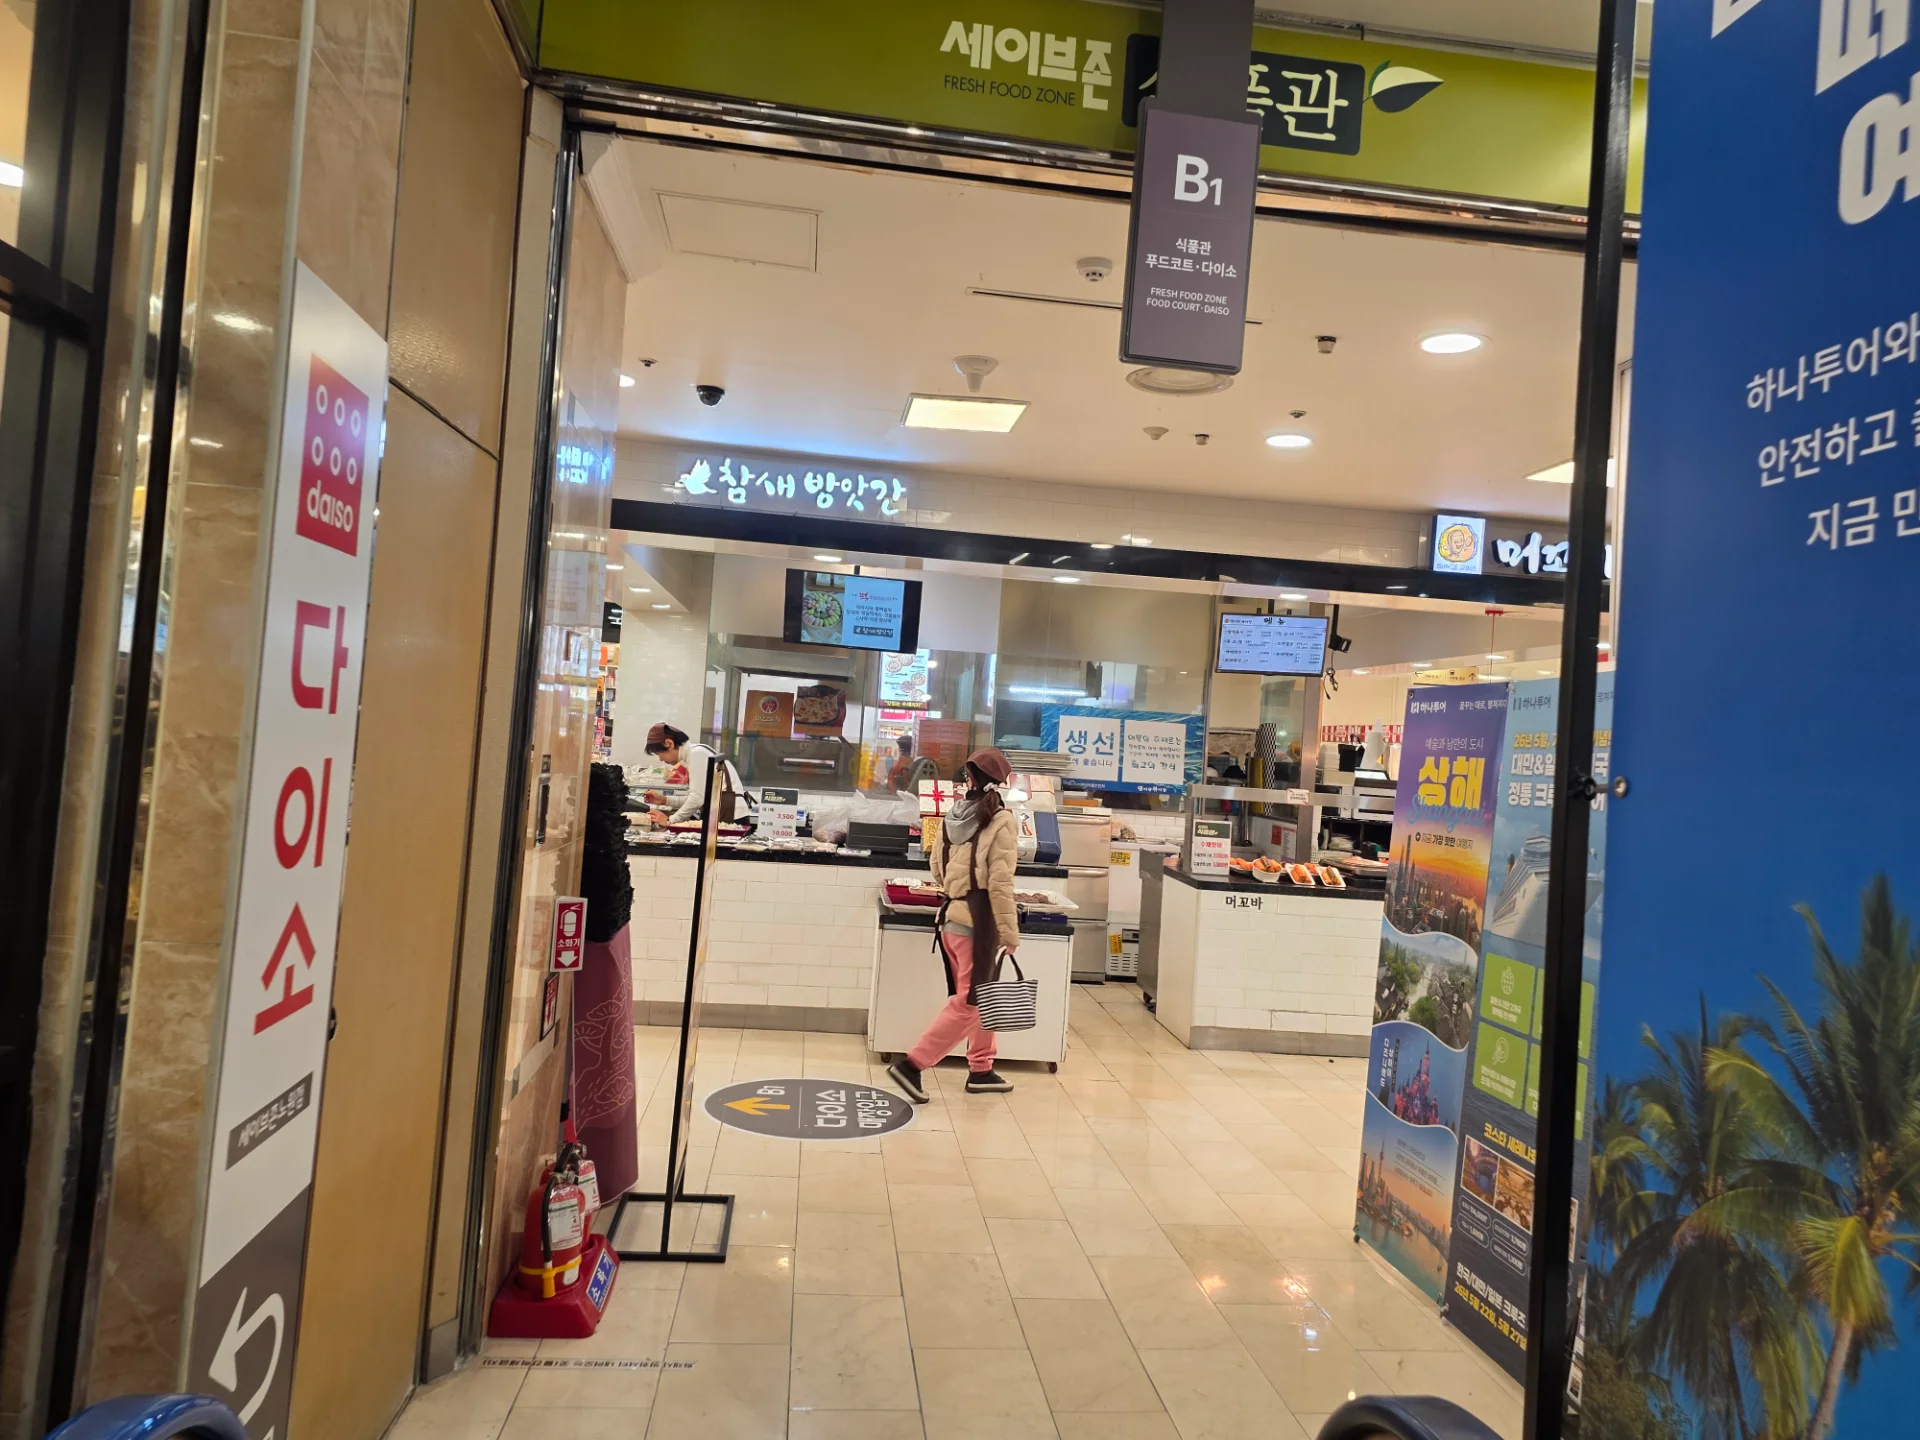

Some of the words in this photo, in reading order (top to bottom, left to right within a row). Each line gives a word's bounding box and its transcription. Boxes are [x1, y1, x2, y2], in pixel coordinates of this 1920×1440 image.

[940, 21, 1112, 111] 세이브존
[944, 75, 985, 94] FRESH
[990, 81, 1032, 100] FOOD
[1036, 88, 1076, 106] ZONE
[1174, 154, 1223, 206] B1
[1175, 237, 1212, 256] 식품관
[1146, 297, 1171, 309] FOOD
[1150, 287, 1178, 298] FRESH
[1179, 291, 1203, 301] FOOD
[1204, 294, 1228, 305] ZONE
[1758, 416, 1898, 487] 안전하고
[306, 480, 354, 533] daiso
[1806, 496, 1880, 550] 지금
[1420, 701, 1447, 713] 하나투어
[1522, 695, 1552, 710] 하나투어
[1064, 730, 1115, 756] 생선
[1425, 738, 1446, 751] 예술과
[1447, 738, 1468, 751] 낭만의
[1469, 738, 1485, 750] 도시
[1418, 756, 1485, 810] 상해
[1508, 782, 1533, 807] 정통
[253, 600, 349, 1036] 다이소
[1432, 834, 1444, 846] 가장
[1225, 896, 1263, 910] 머꼬바
[557, 938, 581, 949] 소화기
[814, 1089, 847, 1128] 다이소
[855, 1090, 893, 1129] 매장입구
[1503, 1299, 1526, 1330] 크루즈
